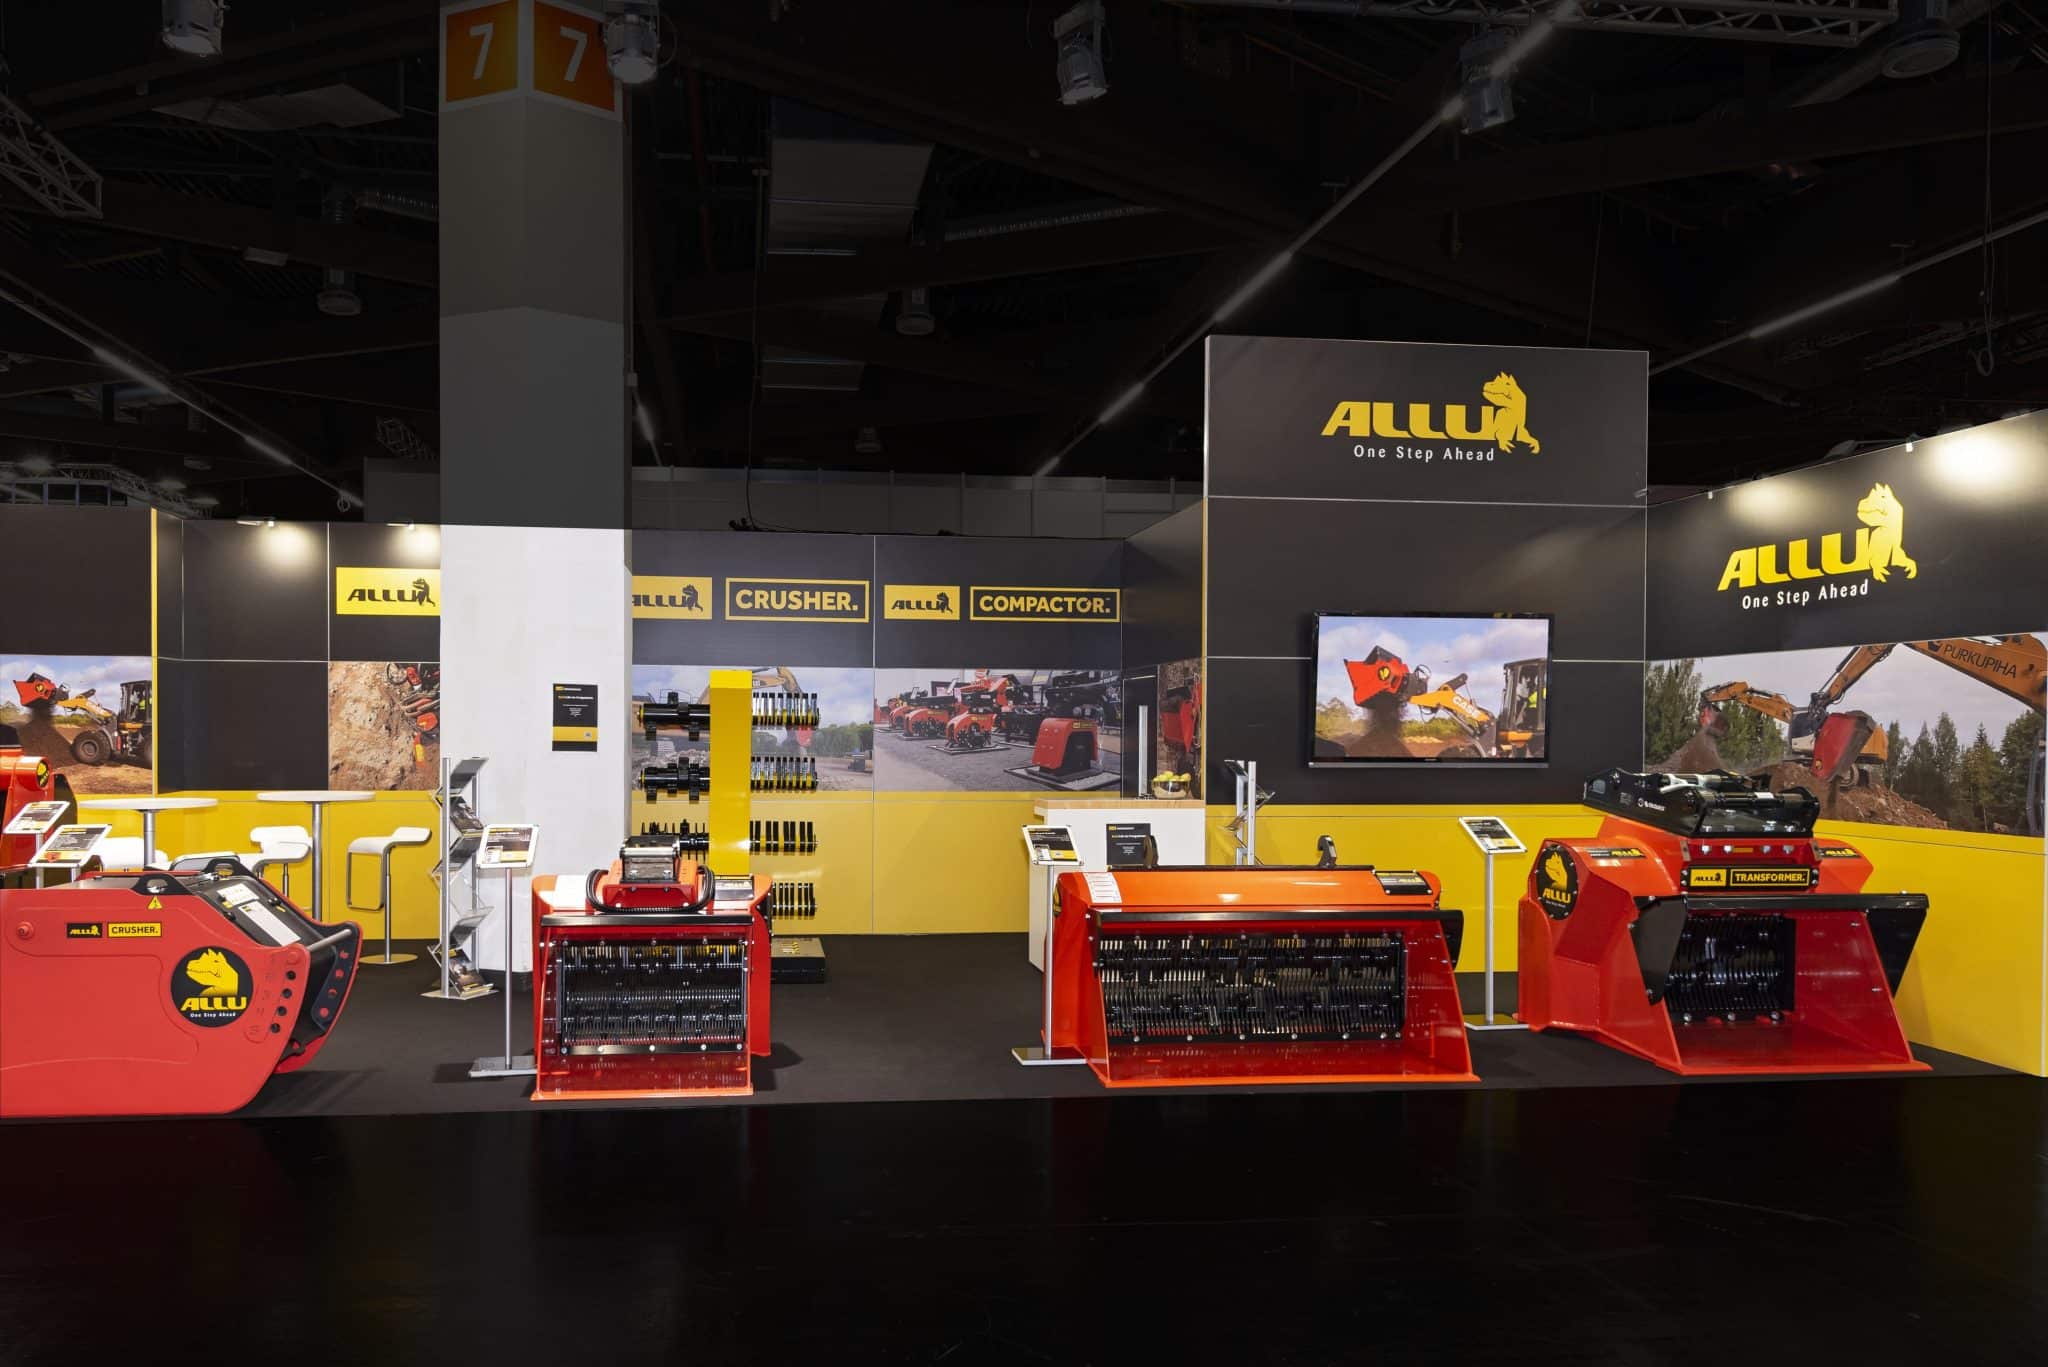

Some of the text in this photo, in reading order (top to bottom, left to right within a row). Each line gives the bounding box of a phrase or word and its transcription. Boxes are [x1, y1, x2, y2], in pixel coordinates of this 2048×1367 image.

[469, 23, 494, 80] 7
[560, 26, 588, 82] 7
[1321, 401, 1497, 440] ALLU
[1353, 444, 1494, 463] One Step Ahead
[1717, 527, 1871, 591] ALLU
[347, 588, 420, 602] ALLU
[735, 589, 858, 611] CRUSHER.
[1742, 578, 1869, 610] One Step Ahead
[891, 599, 943, 611] ALLU
[1944, 643, 2017, 678] PURKUPIHA
[1735, 873, 1805, 882] TRANSFORMER.
[1543, 887, 1571, 904] ALLU
[111, 926, 159, 934] CRUSHER.
[181, 996, 247, 1011] ALLU
